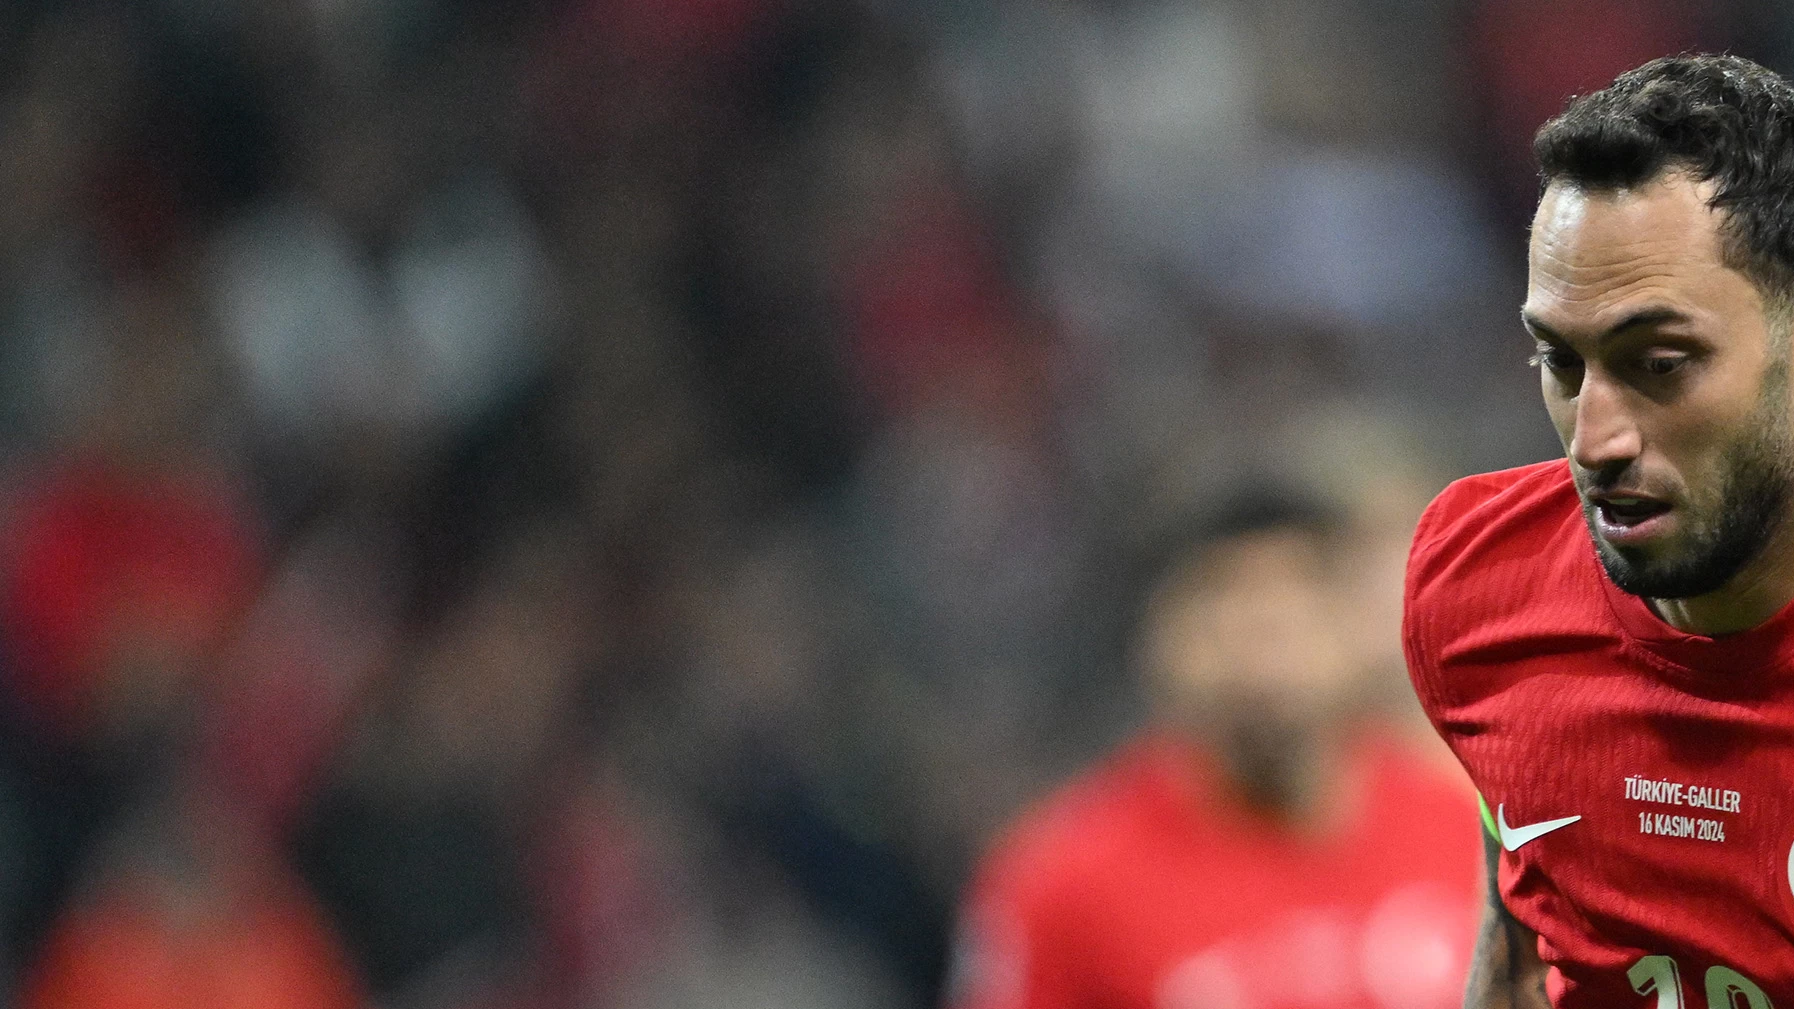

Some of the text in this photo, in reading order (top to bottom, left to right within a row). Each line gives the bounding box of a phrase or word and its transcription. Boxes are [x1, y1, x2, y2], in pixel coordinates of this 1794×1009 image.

[1624, 774, 1741, 813] TÜRKİYE-GALLER
[1638, 811, 1726, 843] 16 KASIM 2024
